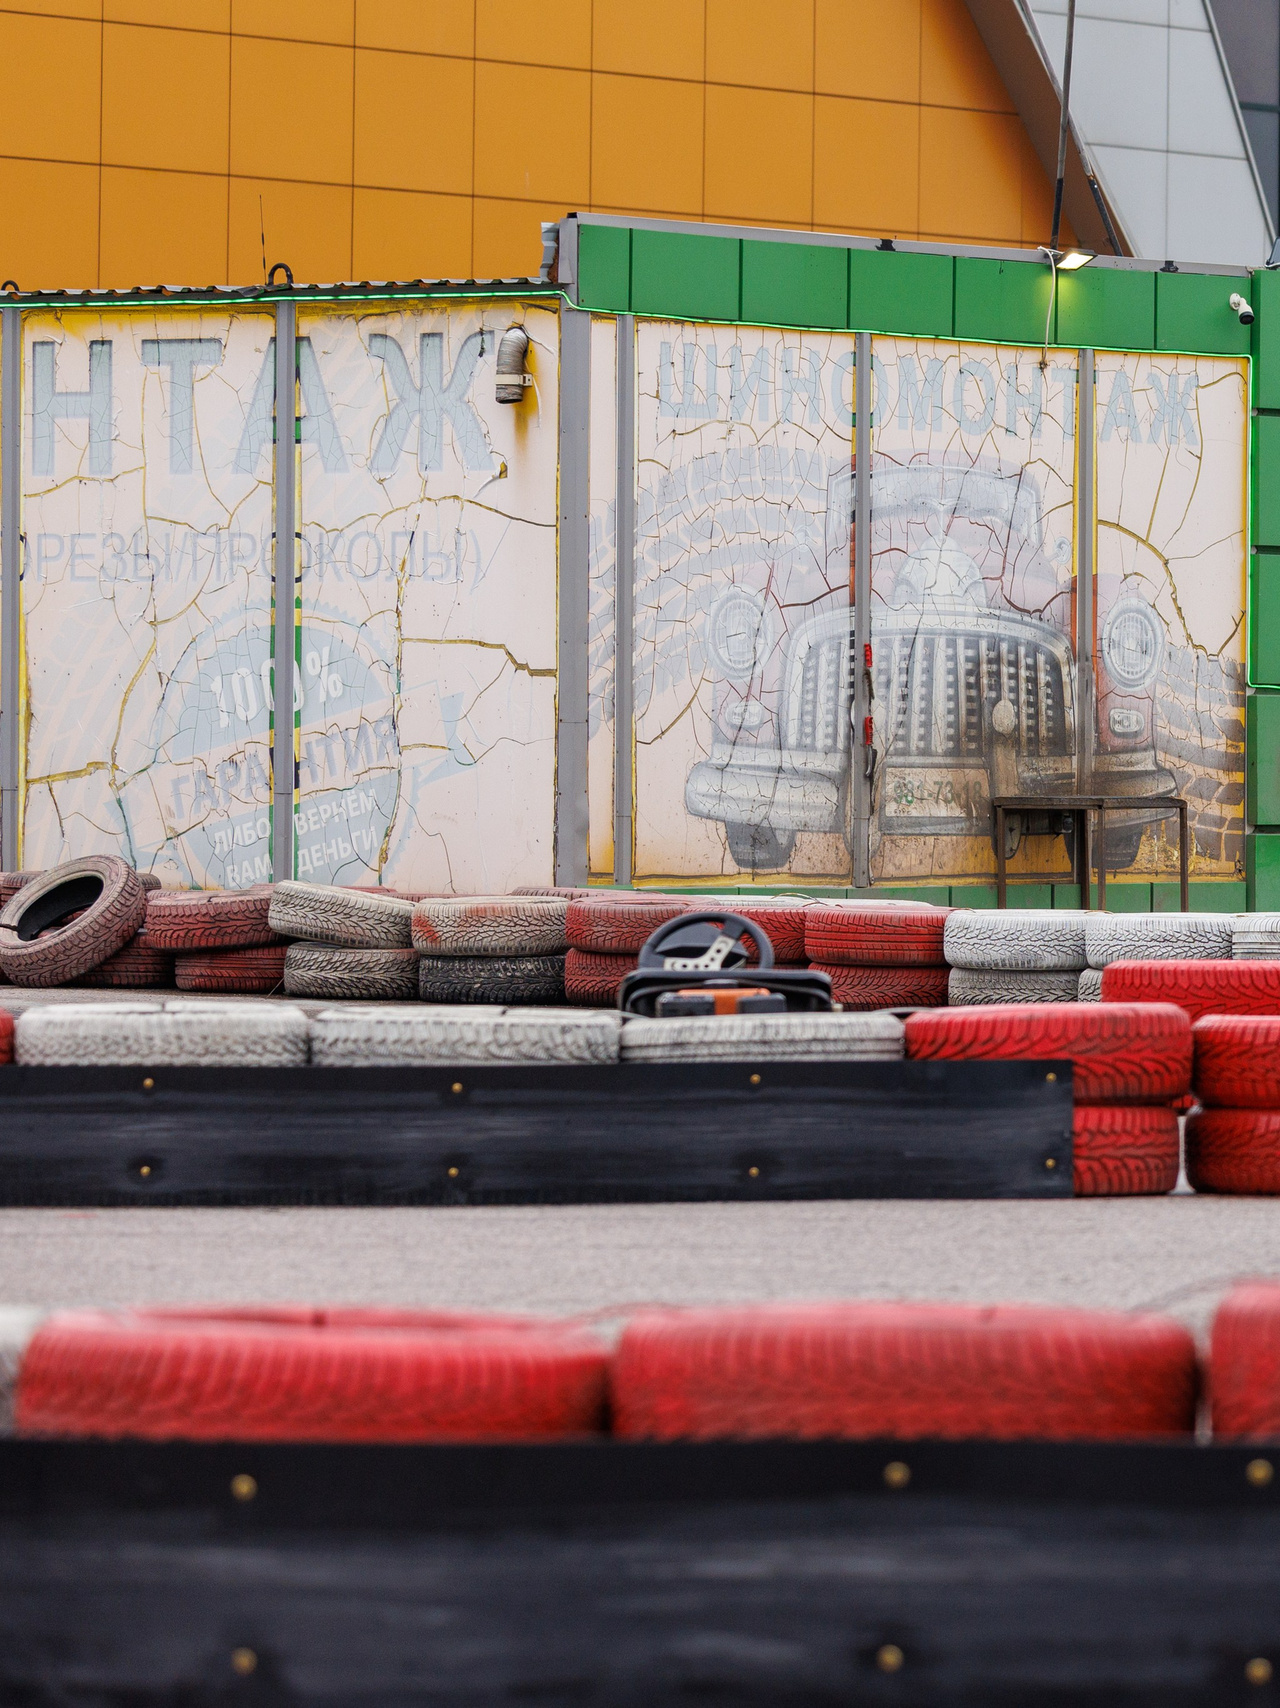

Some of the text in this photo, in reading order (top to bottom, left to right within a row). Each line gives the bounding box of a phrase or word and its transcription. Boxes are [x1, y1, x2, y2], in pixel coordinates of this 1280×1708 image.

[659, 341, 1200, 446] ШИНОМОНТАЖ
[210, 646, 343, 728] 100%
[170, 714, 399, 819] ГАРАНТИЯ
[213, 788, 378, 854] ЛИБО ВЕРНЁМ
[225, 826, 378, 887] ВАМ ДЕНЬГИ
